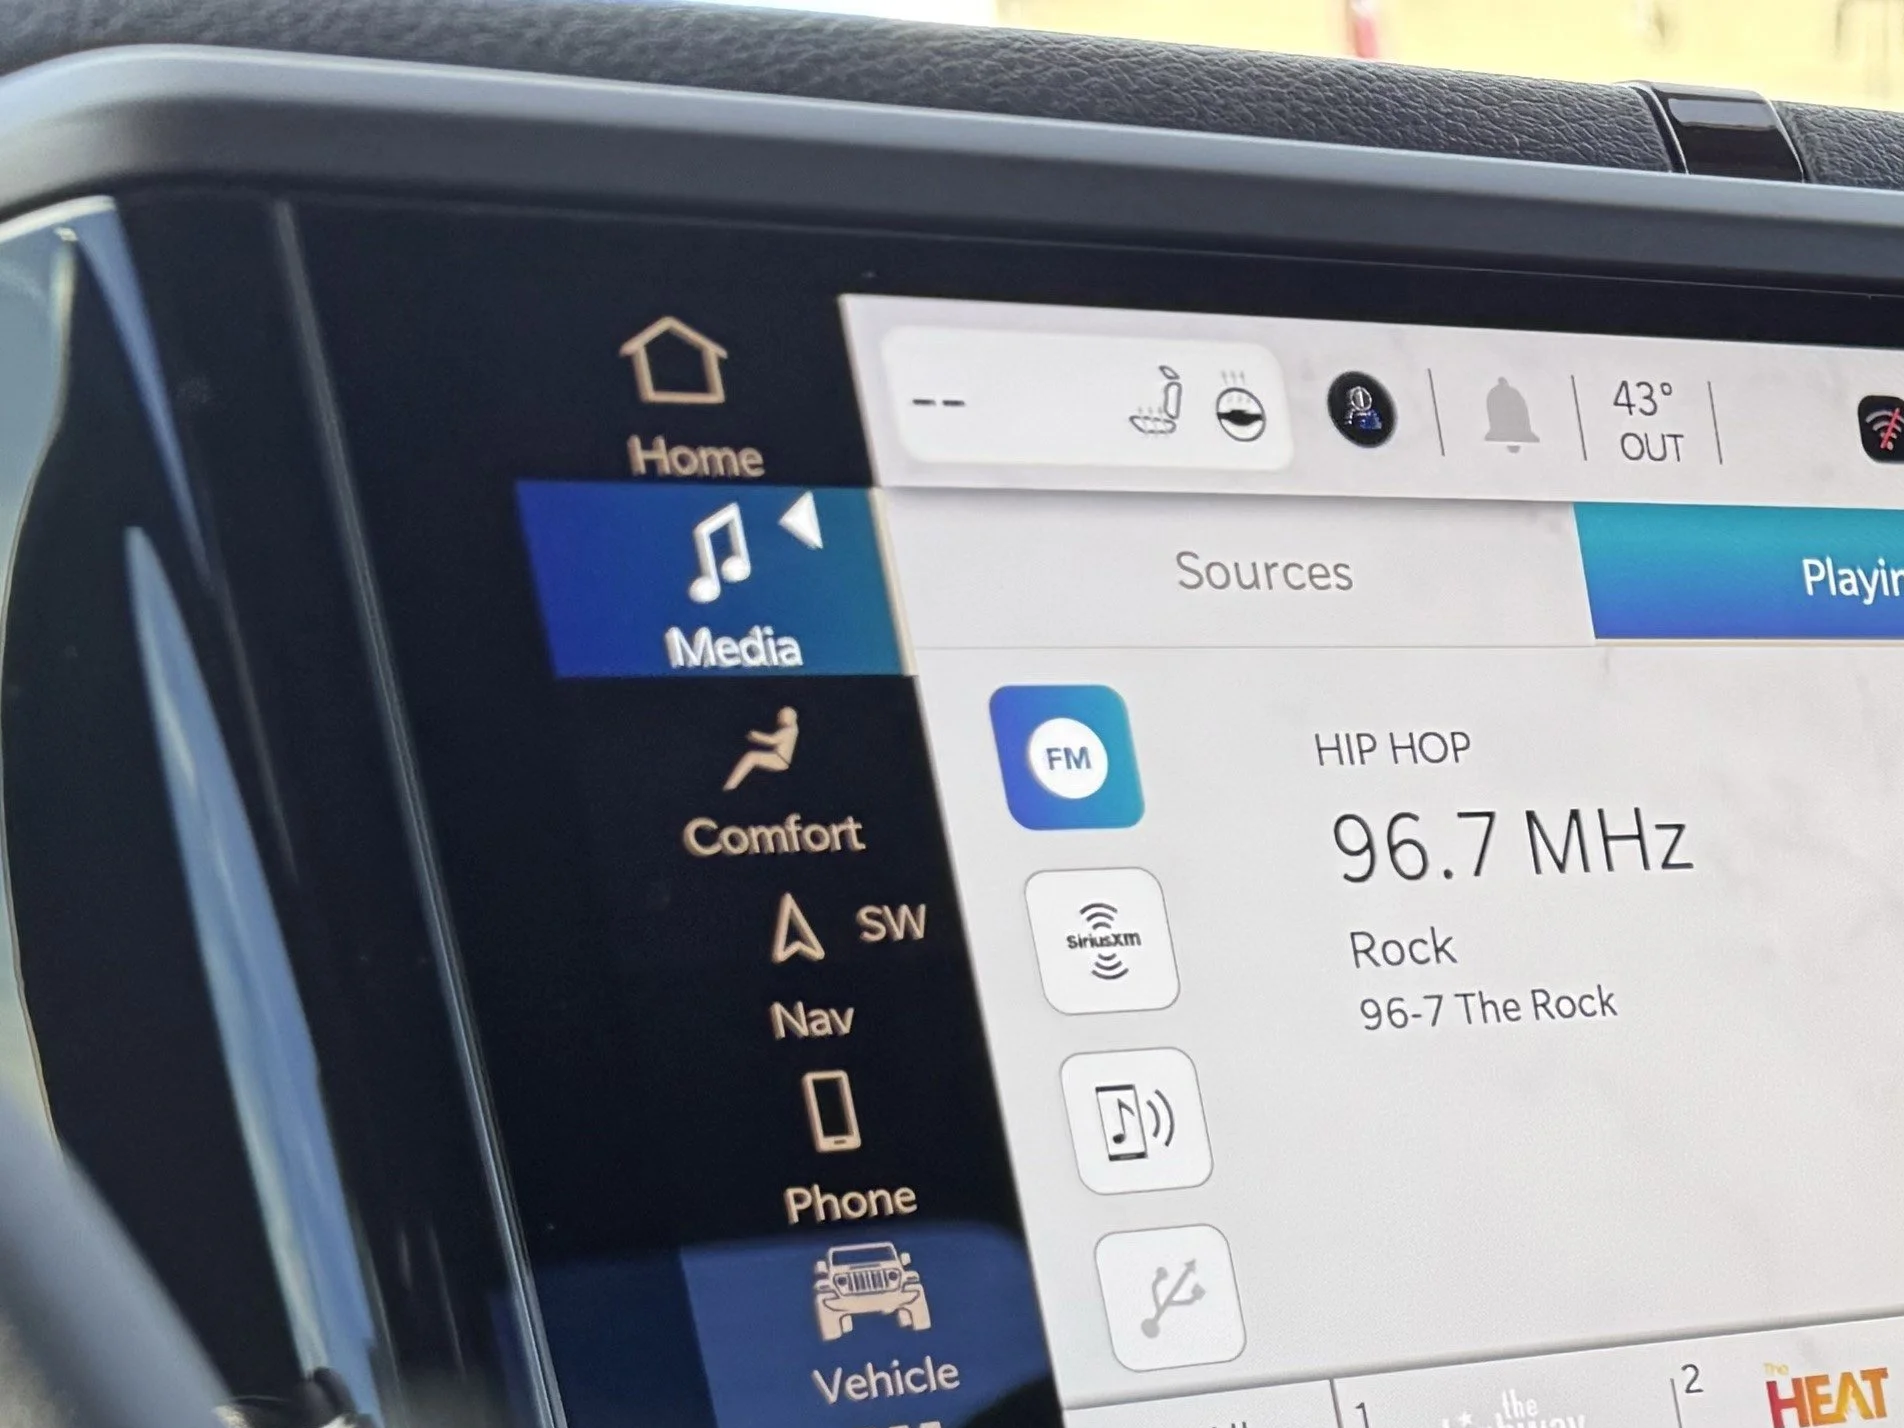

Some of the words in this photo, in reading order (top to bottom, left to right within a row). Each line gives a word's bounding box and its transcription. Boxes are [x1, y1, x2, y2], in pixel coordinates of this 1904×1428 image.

[1612, 380, 1674, 418] 43°
[629, 435, 766, 478] Home
[1620, 433, 1685, 464] OUT
[1175, 550, 1354, 593] Sources
[664, 627, 803, 670] Media
[1046, 745, 1092, 773] FM
[1314, 733, 1377, 767] HIP
[1389, 731, 1472, 765] HOP
[682, 816, 867, 857] Comfort
[1333, 810, 1496, 885] 96.7
[1524, 807, 1695, 876] MHz
[857, 904, 927, 944] SW
[1349, 926, 1458, 969] Rock
[768, 1001, 856, 1041] Nav
[1359, 995, 1445, 1032] 96-7
[1454, 990, 1522, 1026] The
[1530, 985, 1620, 1022] Rock
[784, 1184, 918, 1226] Phone
[811, 1356, 961, 1405] Vehicle
[1681, 1363, 1704, 1395] 2
[1502, 1389, 1539, 1420] the
